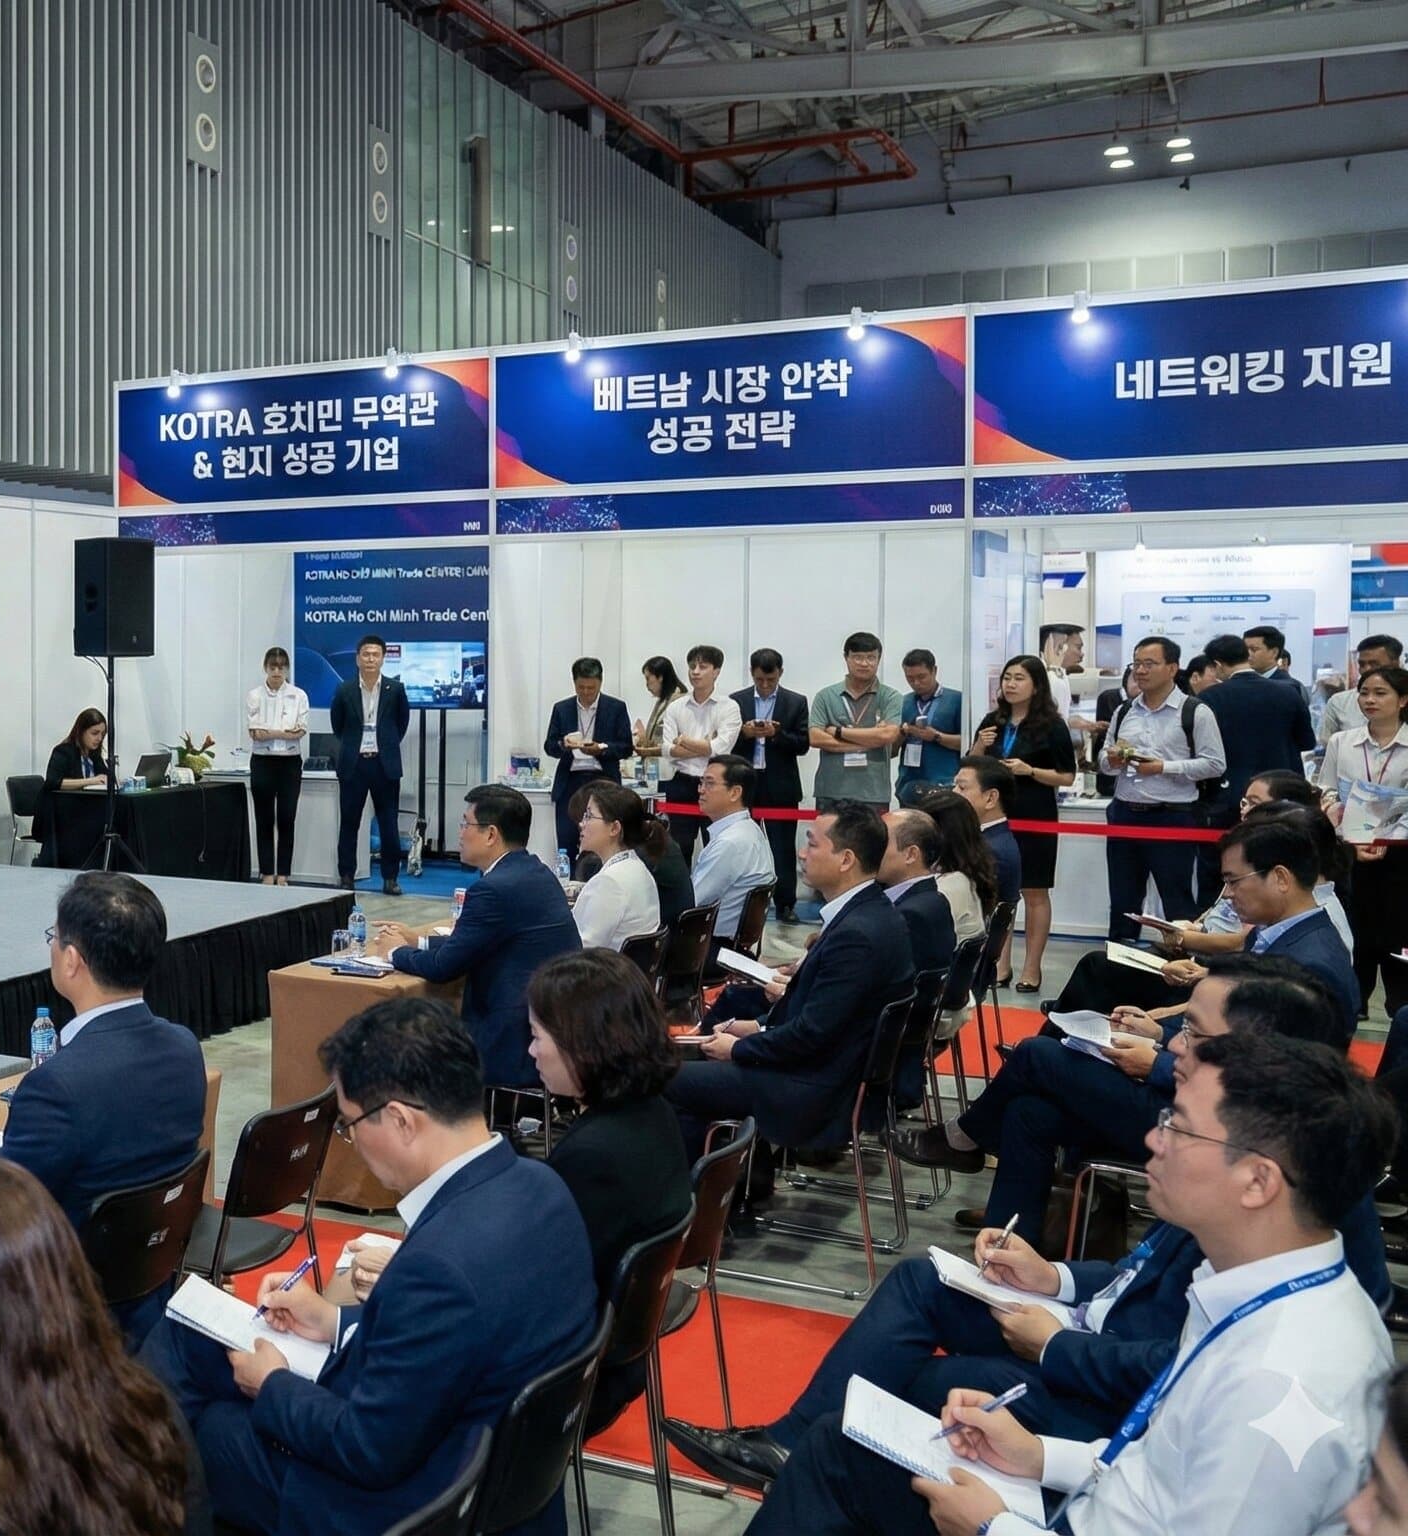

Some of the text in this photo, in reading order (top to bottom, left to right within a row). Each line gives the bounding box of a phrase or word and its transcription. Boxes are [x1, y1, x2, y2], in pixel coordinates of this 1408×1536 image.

[594, 359, 852, 411] 베트남 시장 안착
[1116, 342, 1391, 399] 네트워킹 지원
[159, 391, 439, 442] KOTRA 호치민 무역관
[648, 410, 795, 453] 성공 전략
[194, 437, 398, 479] & 현지 성공 기업
[305, 610, 346, 623] KOTRA
[348, 611, 365, 622] Ho
[422, 608, 458, 621] Trade
